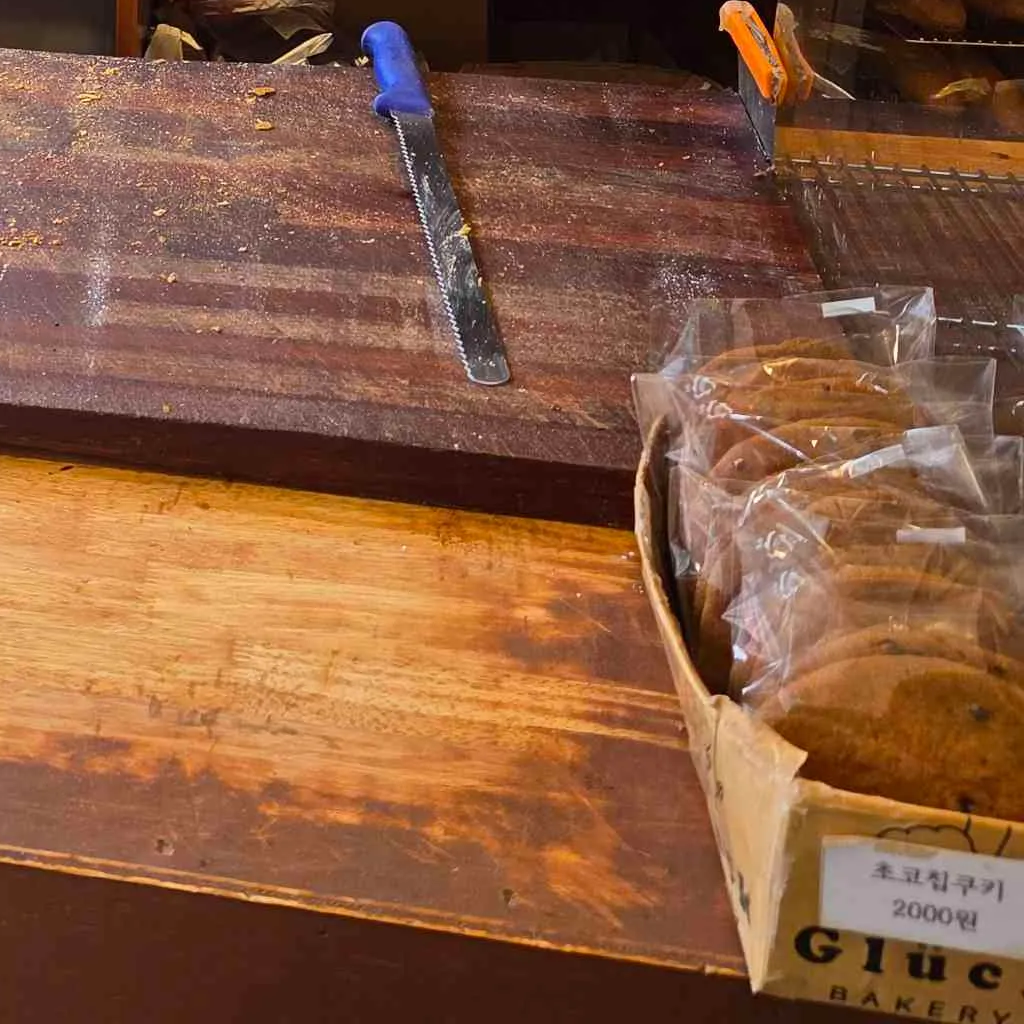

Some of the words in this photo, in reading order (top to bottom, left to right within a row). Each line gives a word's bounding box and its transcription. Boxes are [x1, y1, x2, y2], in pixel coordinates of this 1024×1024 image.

[892, 898, 979, 933] 2000원
[794, 926, 1024, 1001] Glüc
[829, 985, 1011, 1024] BAKERY
